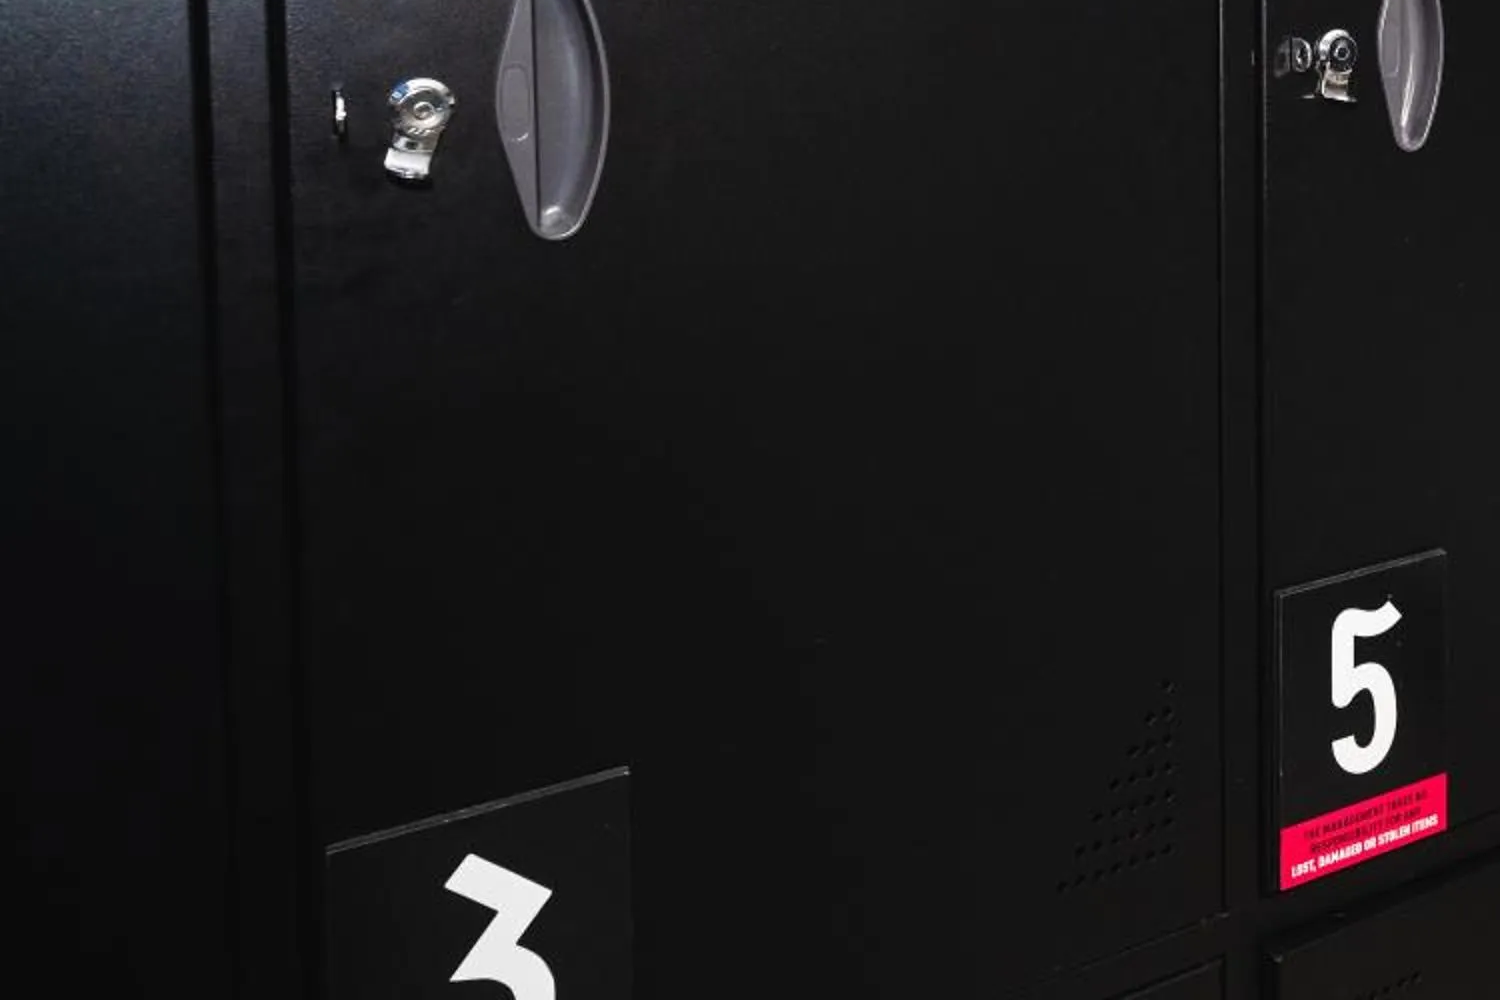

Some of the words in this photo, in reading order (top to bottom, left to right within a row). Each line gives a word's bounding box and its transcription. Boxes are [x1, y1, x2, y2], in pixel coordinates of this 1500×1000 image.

[1331, 600, 1403, 775] 5
[1291, 858, 1317, 878] LOST,
[1318, 841, 1362, 869] DAMAGED
[1364, 838, 1377, 852] OR
[1377, 823, 1411, 847] STOLEN
[1410, 813, 1439, 833] ITEMS
[444, 853, 556, 1000] 3
